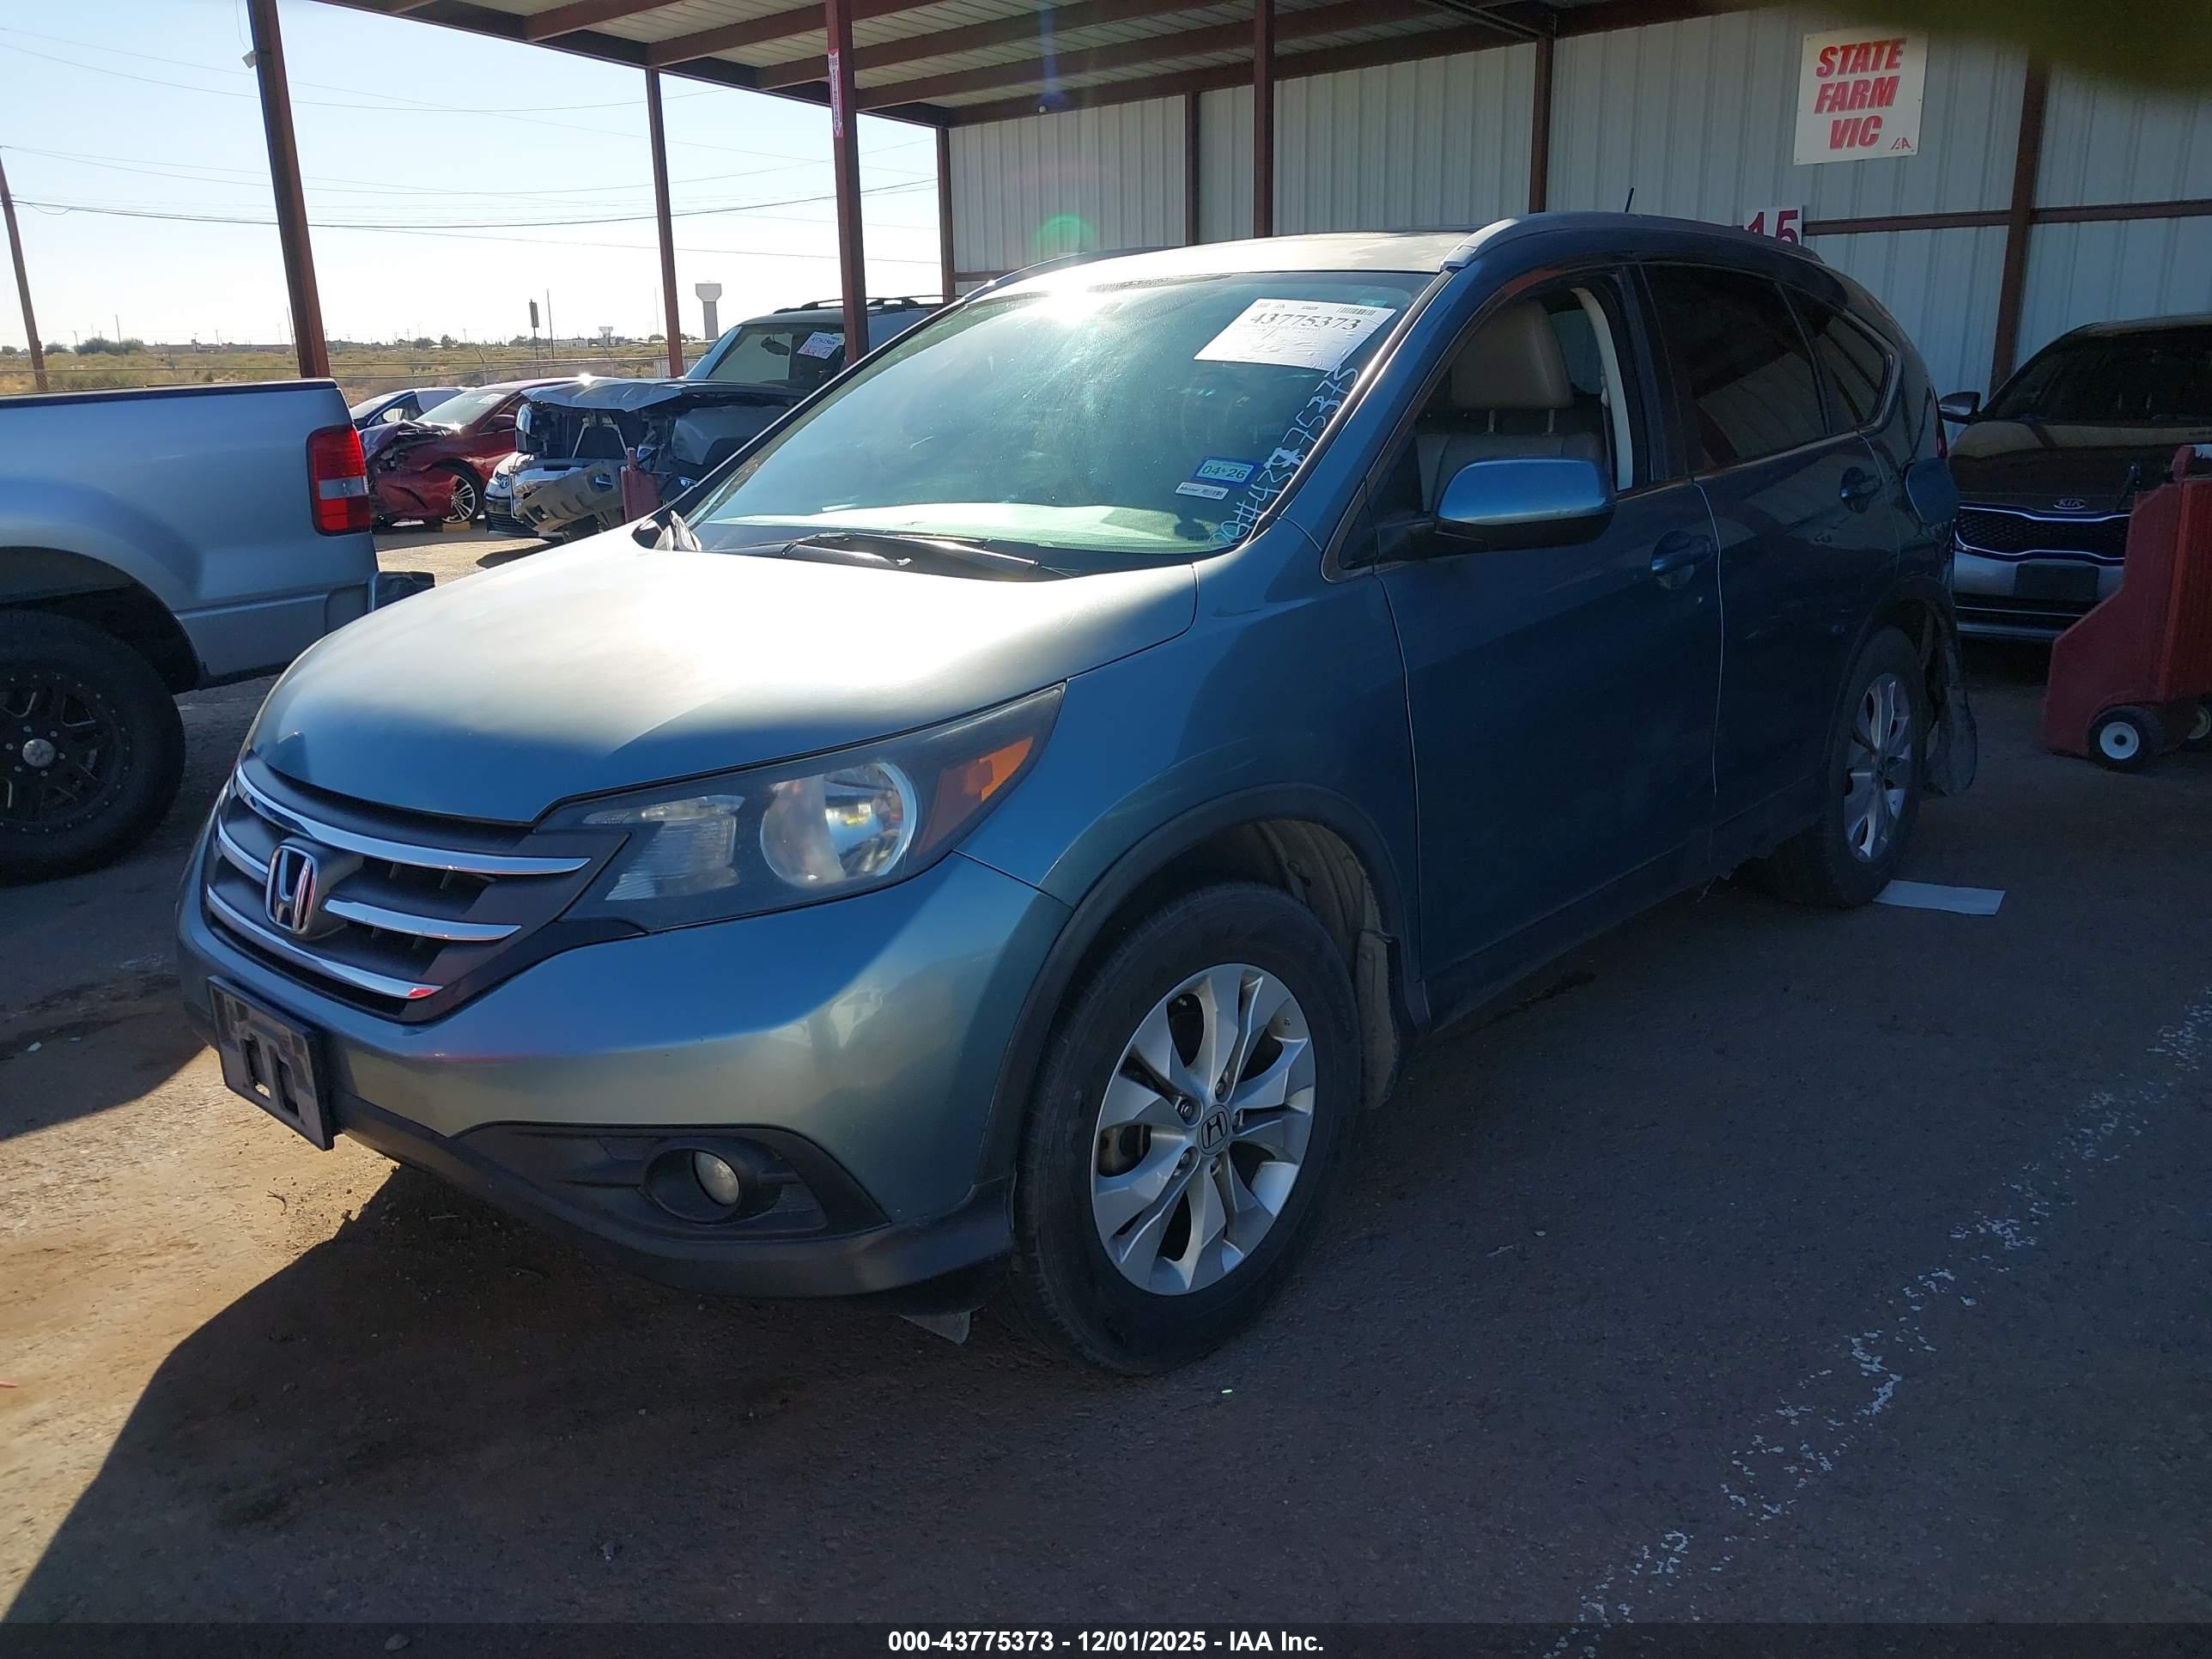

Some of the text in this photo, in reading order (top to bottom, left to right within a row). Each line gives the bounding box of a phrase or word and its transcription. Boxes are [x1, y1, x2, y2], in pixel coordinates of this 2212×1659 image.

[1815, 37, 1907, 78] STATE
[1814, 76, 1901, 115] FARM
[1829, 115, 1883, 150] VIC
[1249, 312, 1362, 331] 43775373
